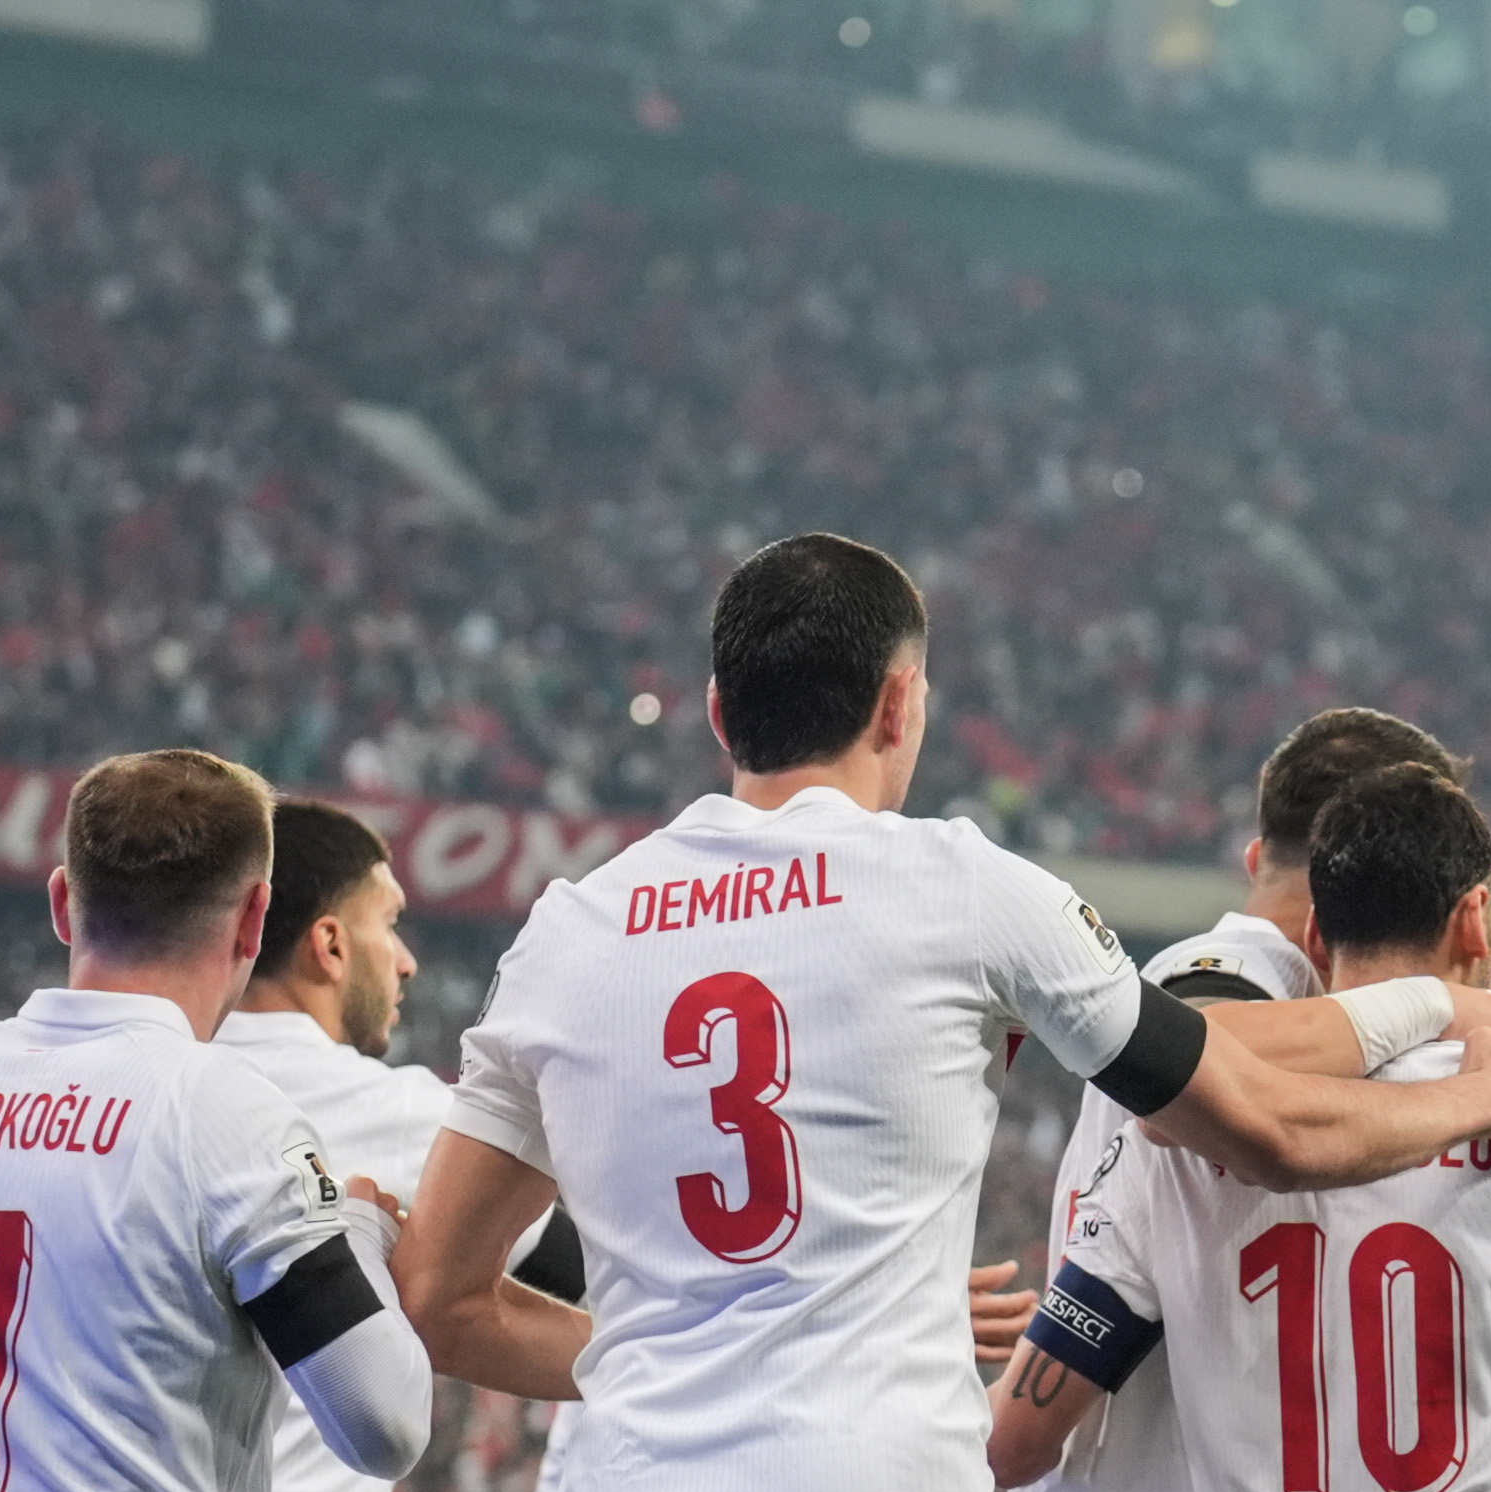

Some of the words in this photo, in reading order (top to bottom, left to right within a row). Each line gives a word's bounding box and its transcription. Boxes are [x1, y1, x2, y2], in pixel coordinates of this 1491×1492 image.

[626, 852, 844, 936] DEMİRAL
[663, 970, 804, 1265] 3
[1043, 1289, 1111, 1342] RESPECT
